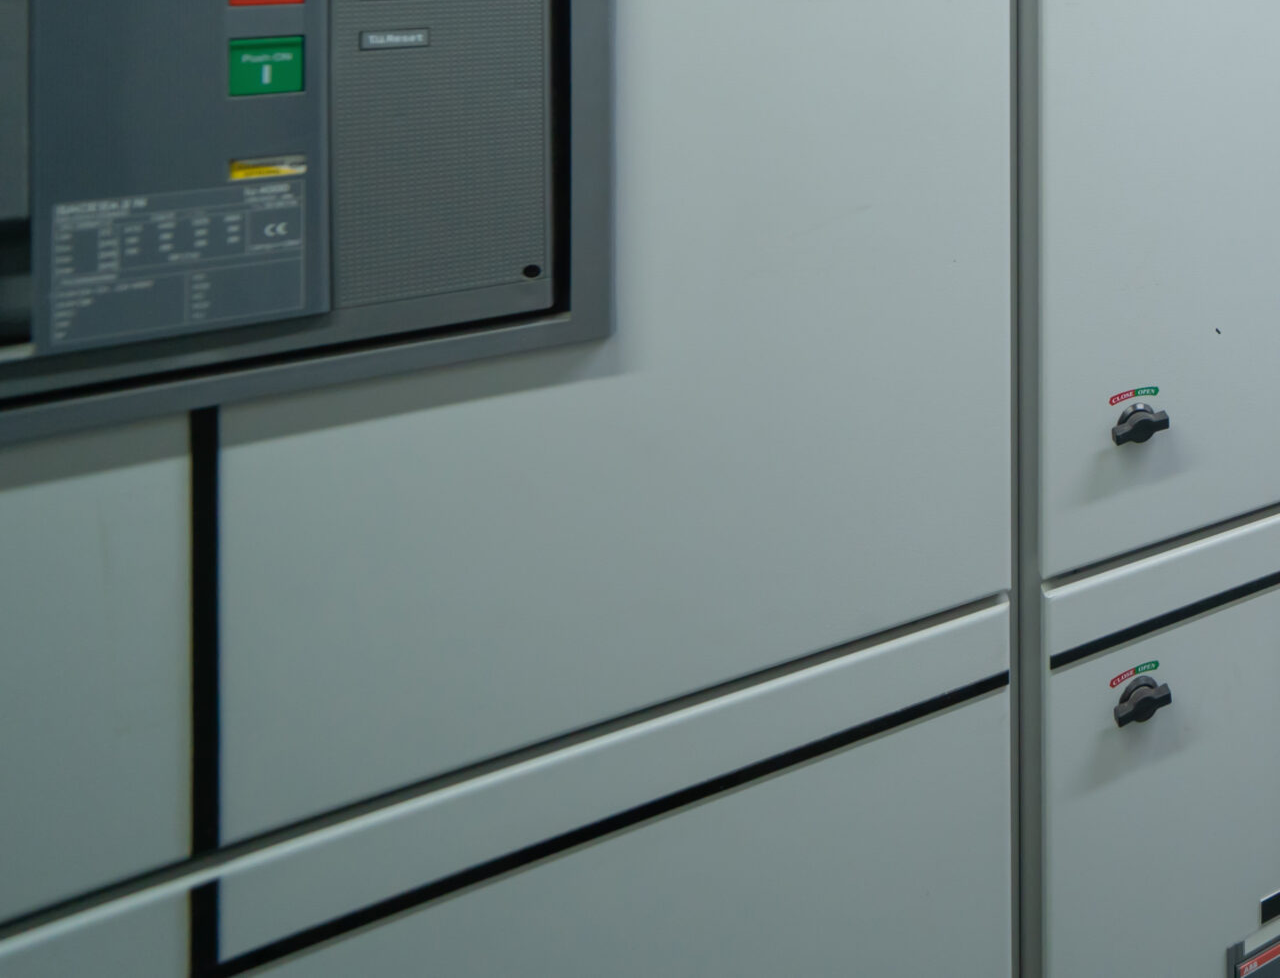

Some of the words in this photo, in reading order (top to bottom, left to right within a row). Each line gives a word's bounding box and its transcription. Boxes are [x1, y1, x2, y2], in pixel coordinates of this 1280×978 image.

[1111, 390, 1134, 404] CLOSE
[1137, 387, 1157, 396] OPEN
[1112, 669, 1135, 686] CLOSE
[1138, 663, 1157, 672] OPEN
[1243, 961, 1258, 975] ABB
